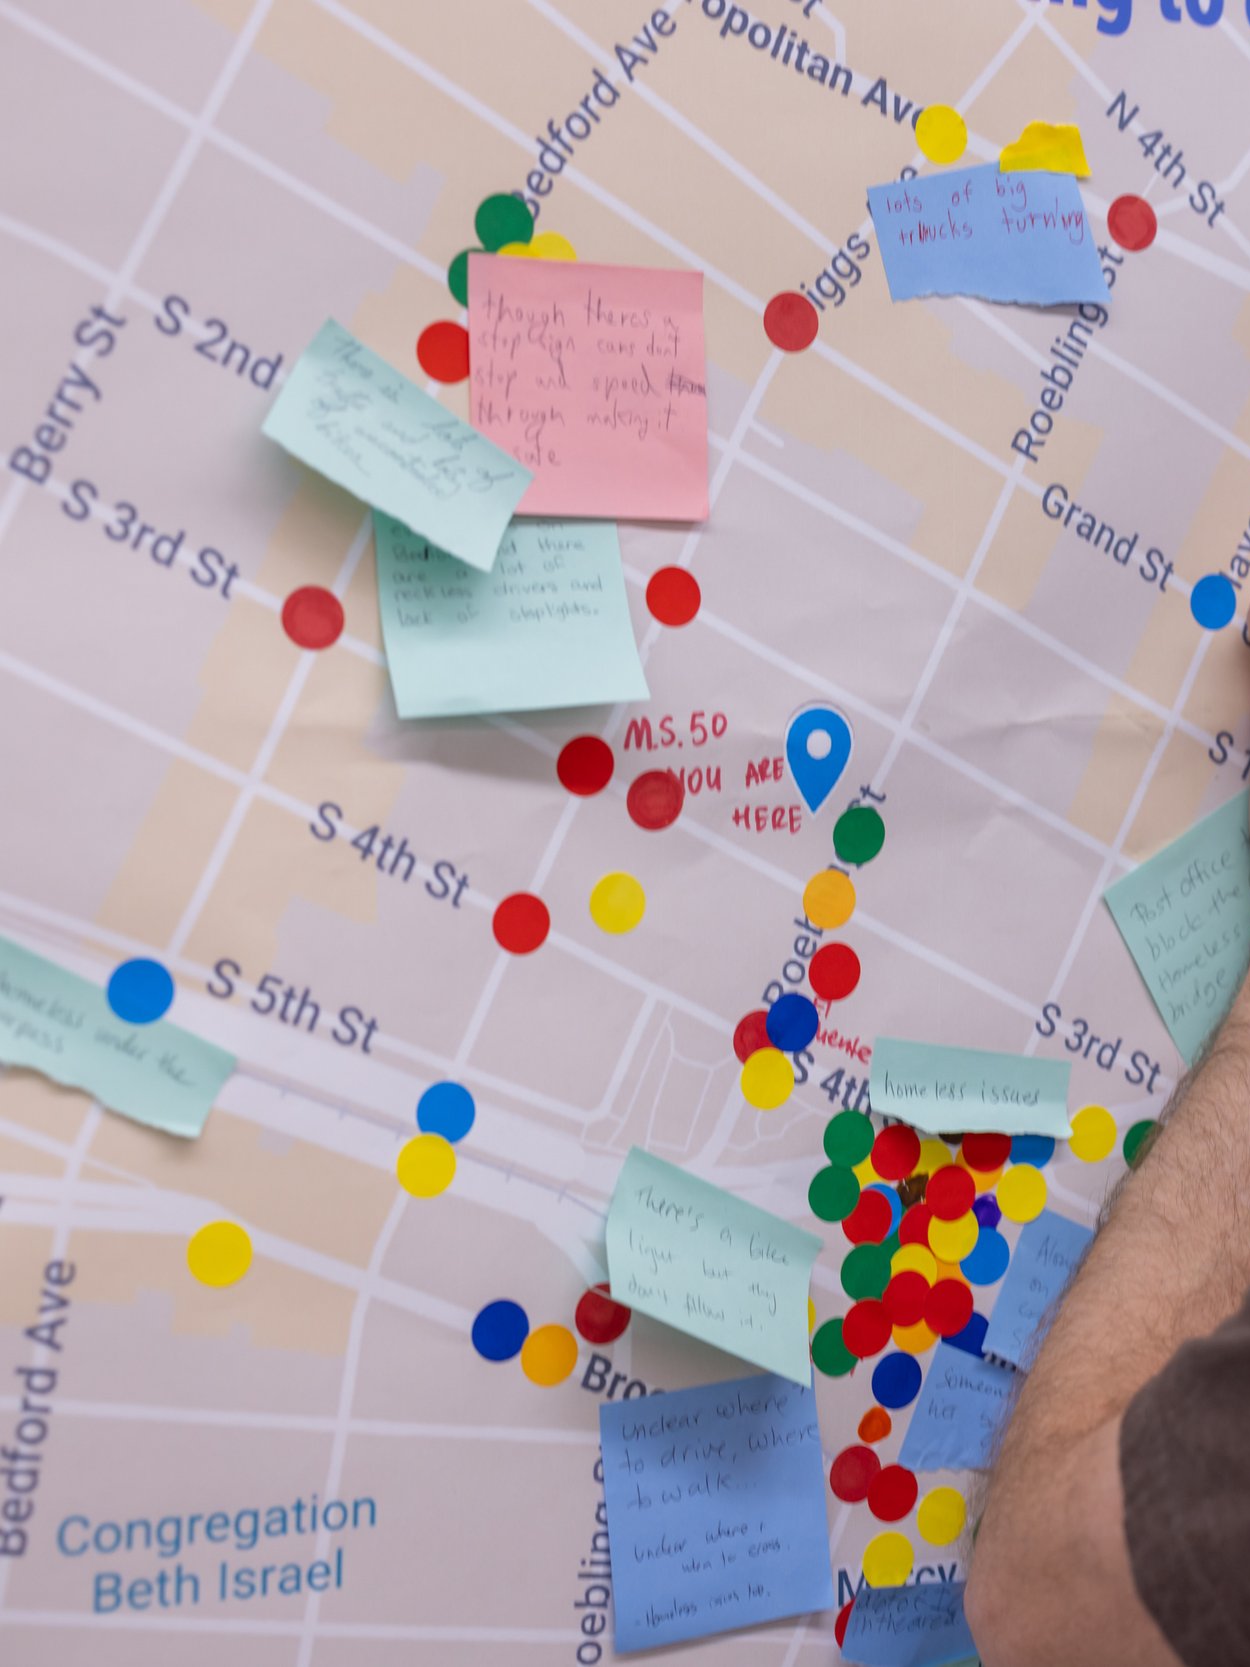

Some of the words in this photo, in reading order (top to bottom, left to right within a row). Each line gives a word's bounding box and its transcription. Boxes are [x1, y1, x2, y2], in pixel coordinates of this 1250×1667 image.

[613, 7, 677, 83] Ave
[688, 0, 854, 96] opolitan
[951, 179, 972, 207] of
[995, 176, 1027, 212] big
[1105, 89, 1140, 132] N
[1137, 129, 1187, 189] 4th
[1188, 180, 1227, 229] St
[154, 293, 190, 336] S
[193, 317, 284, 391] 2nd
[475, 359, 518, 400] stop
[1010, 302, 1109, 463] Roebling
[8, 362, 102, 485] Berry
[74, 304, 127, 357] St
[61, 477, 99, 522] S
[104, 500, 187, 569] 3rd
[190, 545, 240, 600] St
[1041, 483, 1138, 566] Grand
[1138, 547, 1175, 592] St
[689, 711, 729, 748] 50
[1208, 730, 1234, 766] S
[745, 756, 785, 789] ARE
[308, 799, 345, 843] S
[349, 821, 419, 886] 4th
[423, 858, 471, 908] St
[732, 804, 802, 835] HERE
[205, 957, 243, 999] S
[249, 972, 322, 1036] 5th
[331, 1006, 380, 1055] St
[1035, 1001, 1062, 1038] S
[1064, 1017, 1123, 1072] 3rd
[1124, 1050, 1161, 1095] St
[791, 1047, 815, 1085] S
[24, 1260, 77, 1352] Ave
[580, 1352, 666, 1401] Bro
[55, 1492, 377, 1557] Congregation
[92, 1565, 200, 1615] Beth
[218, 1548, 344, 1601] Israel
